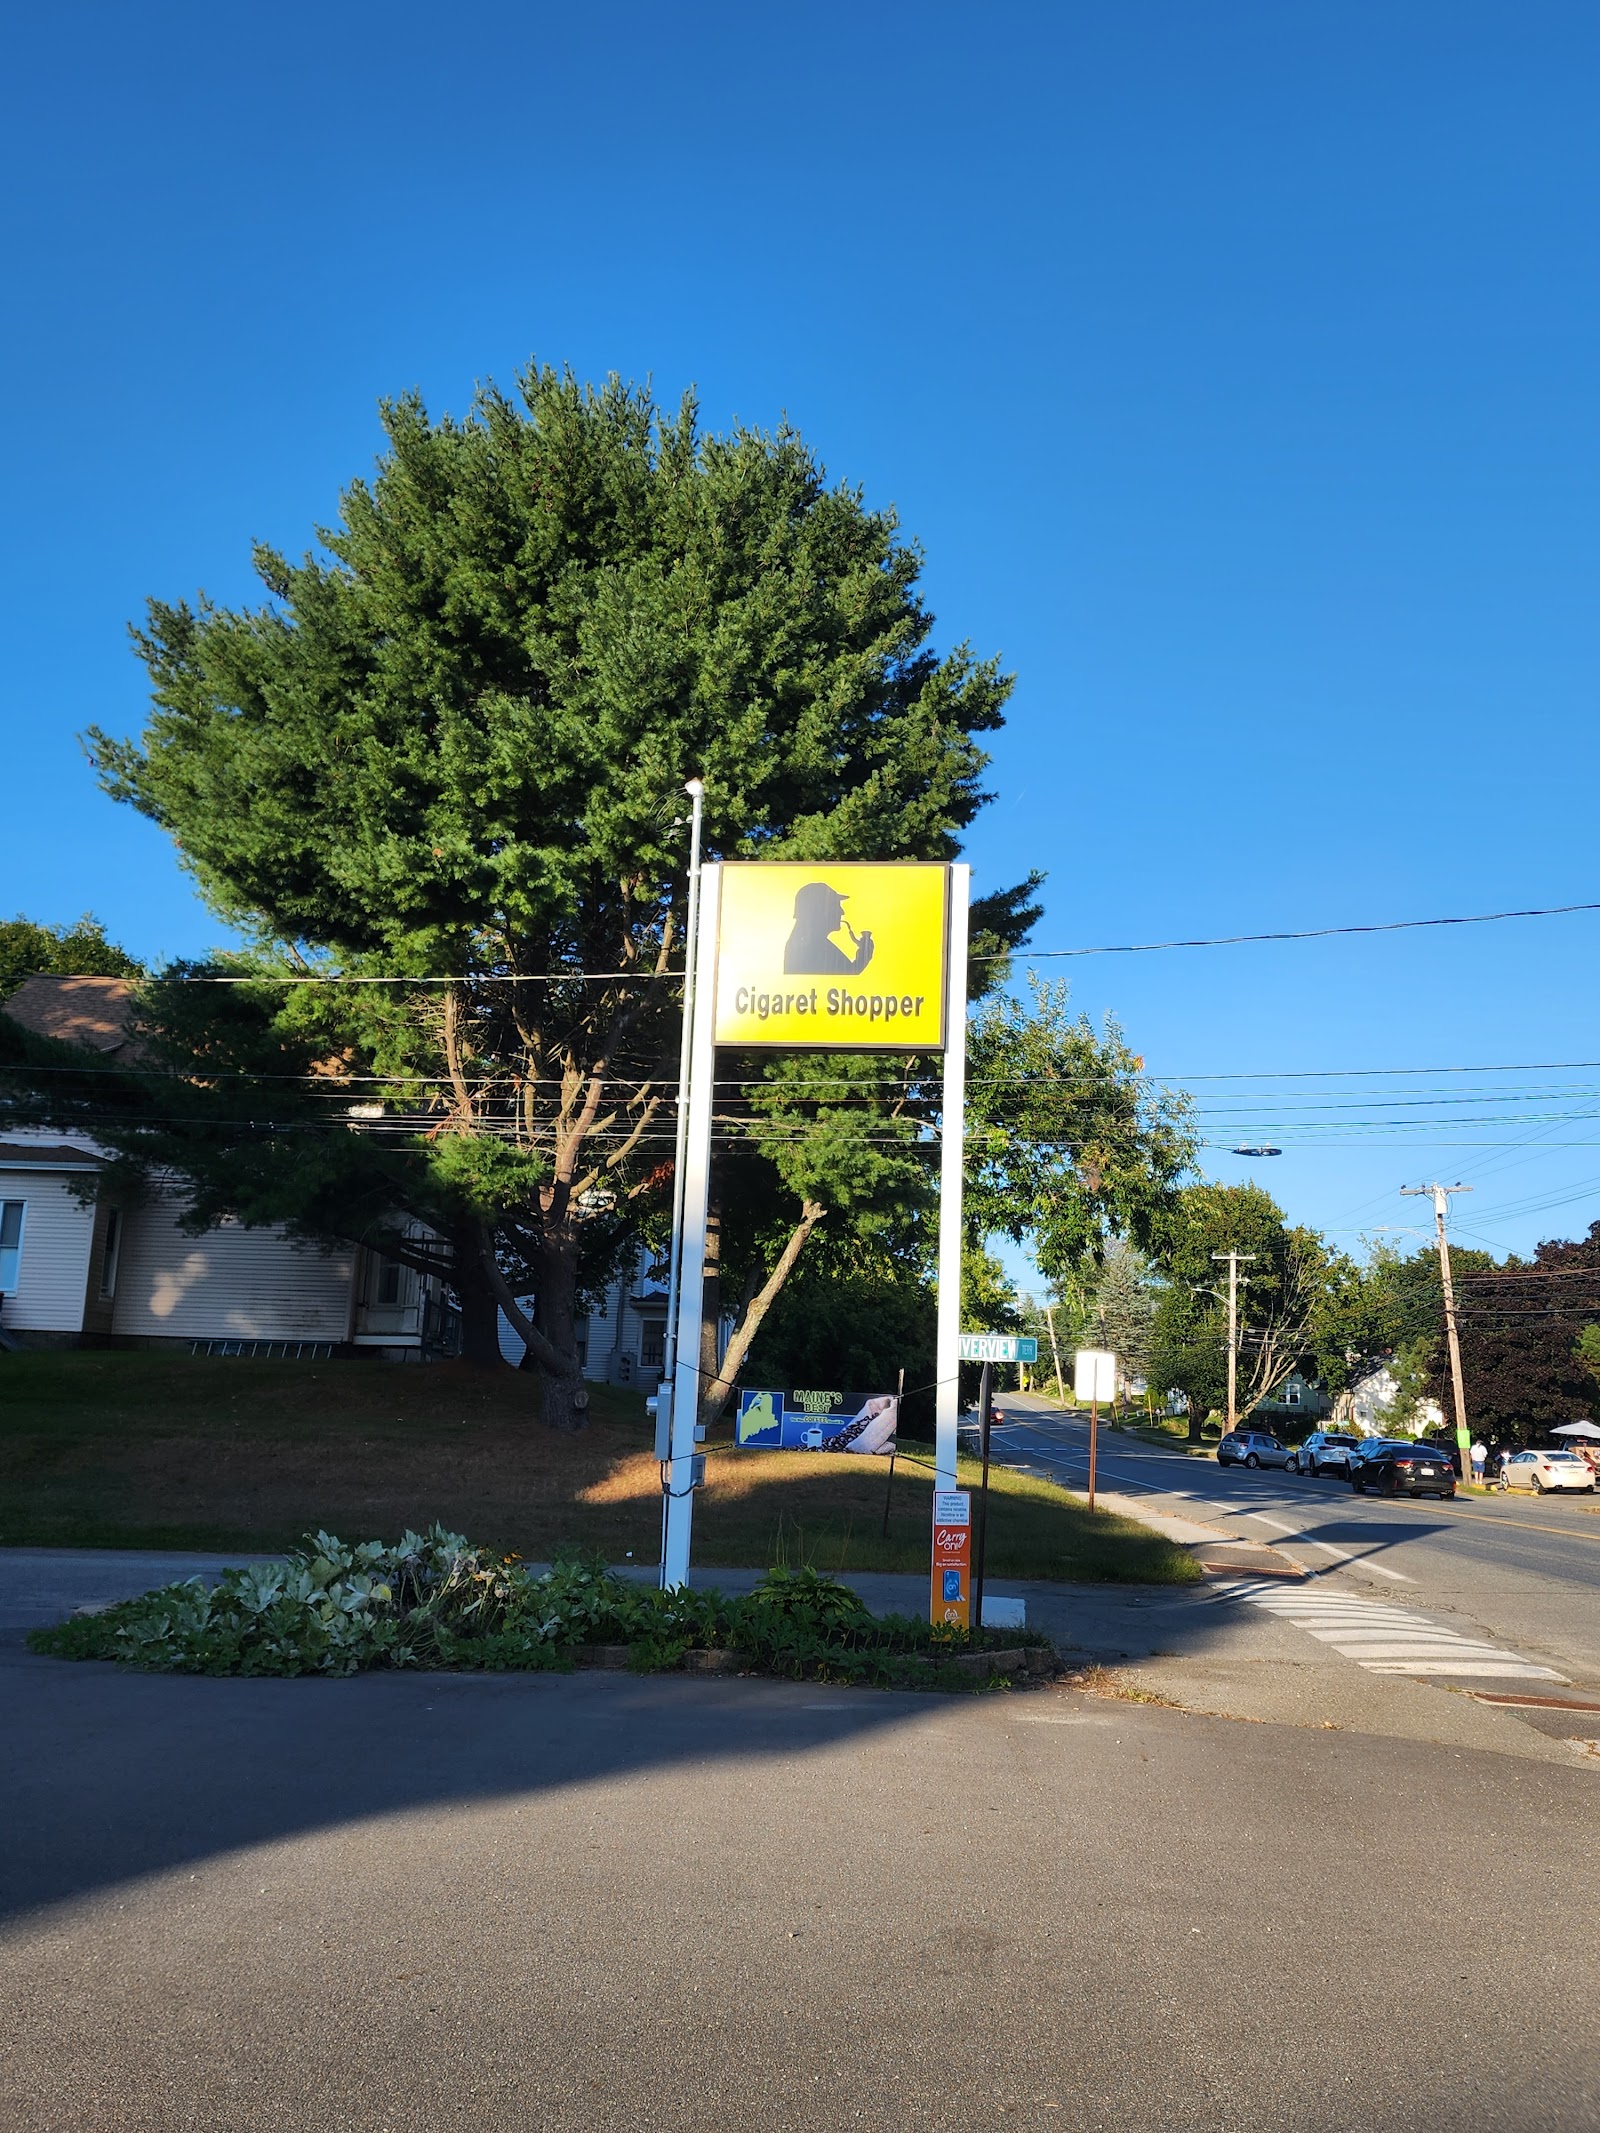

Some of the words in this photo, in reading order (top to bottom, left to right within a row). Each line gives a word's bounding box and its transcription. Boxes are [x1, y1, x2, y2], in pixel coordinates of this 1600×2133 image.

[735, 987, 817, 1020] Cigaret
[827, 988, 924, 1022] Shopper
[957, 1338, 1019, 1359] IVERVIEW
[793, 1390, 843, 1405] MAINE'S
[804, 1403, 831, 1413] BEST
[937, 1529, 967, 1548] Carry
